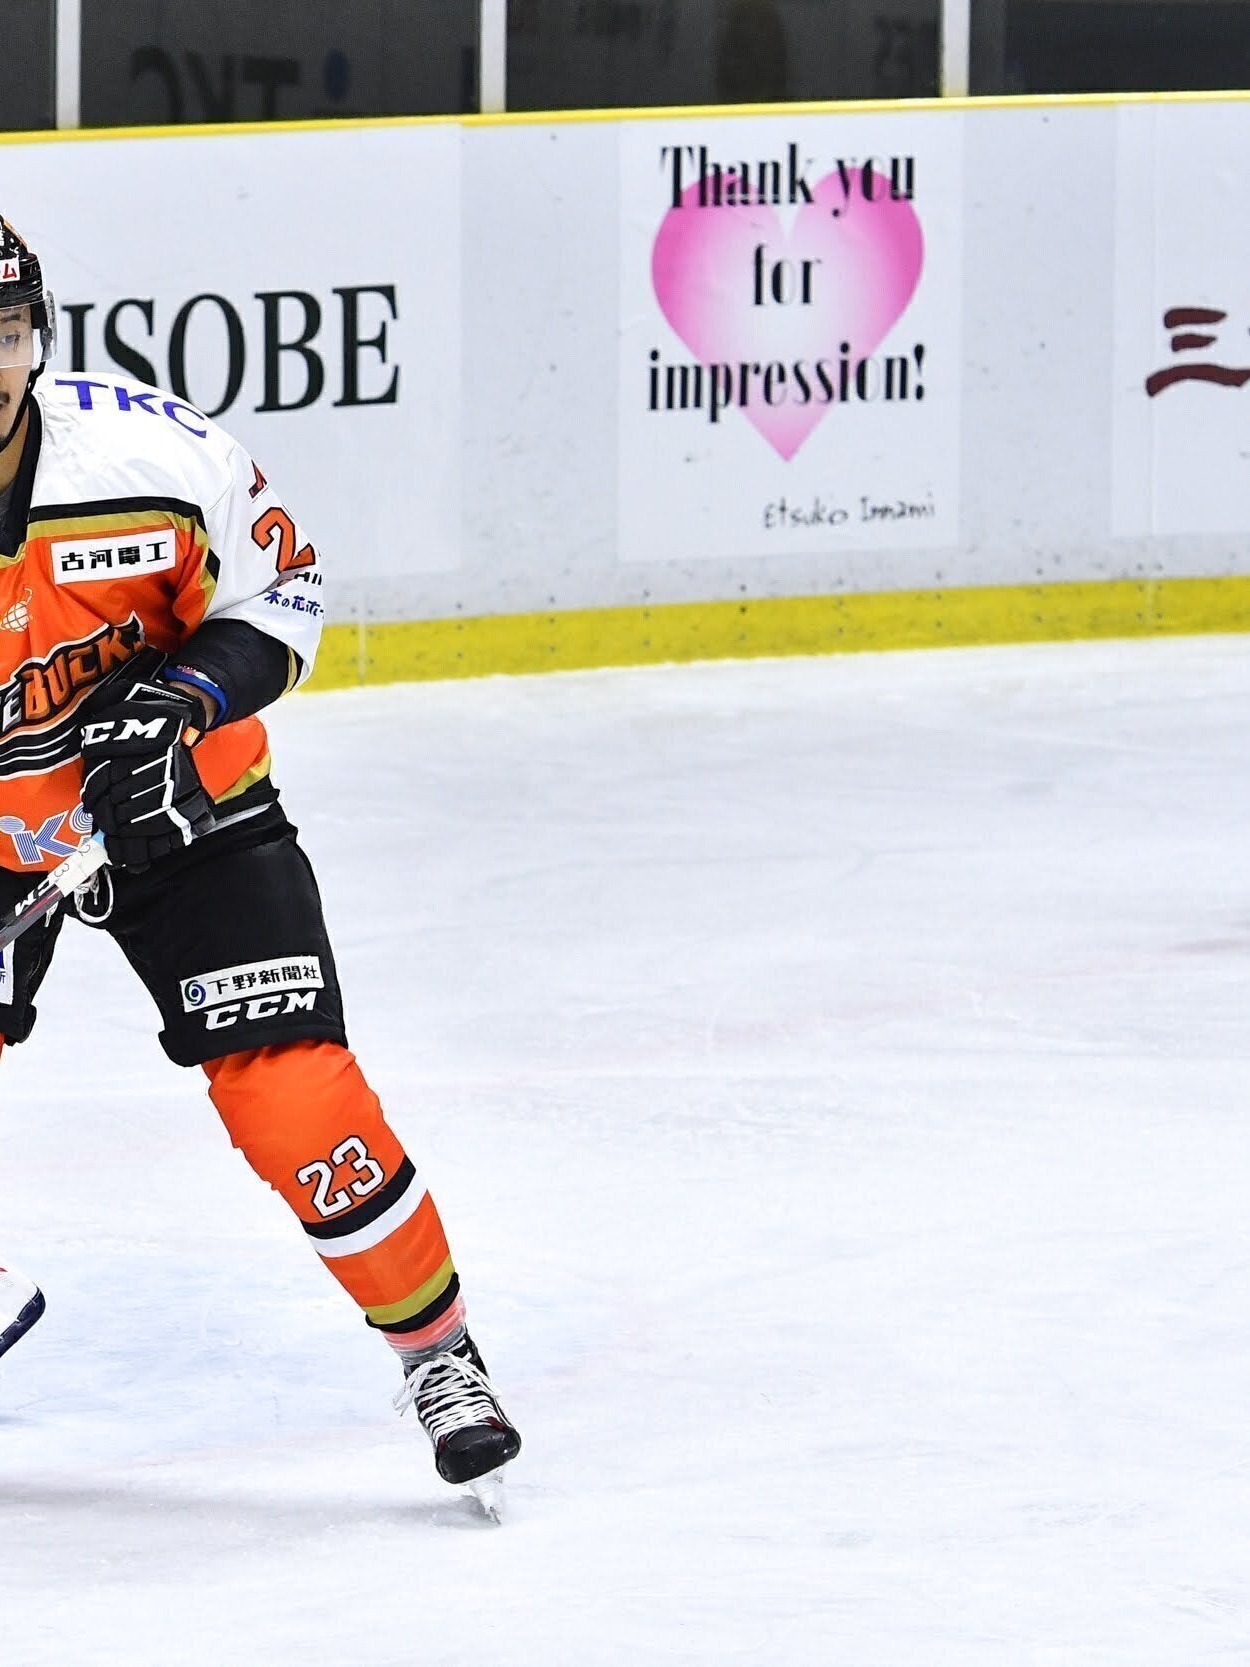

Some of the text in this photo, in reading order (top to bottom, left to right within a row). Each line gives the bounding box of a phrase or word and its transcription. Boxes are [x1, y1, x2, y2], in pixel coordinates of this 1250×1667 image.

[661, 143, 917, 217] Thank you
[751, 243, 822, 307] for
[62, 284, 400, 419] ISOBE
[646, 341, 927, 423] impression!
[54, 378, 208, 439] TKC
[60, 541, 168, 573] 古河電工
[250, 506, 316, 576] 2
[263, 589, 325, 618] 木の花ホ
[80, 717, 168, 748] CM
[204, 990, 318, 1031] CCM
[206, 964, 320, 996] 下野新聞社
[296, 1134, 385, 1218] 23
